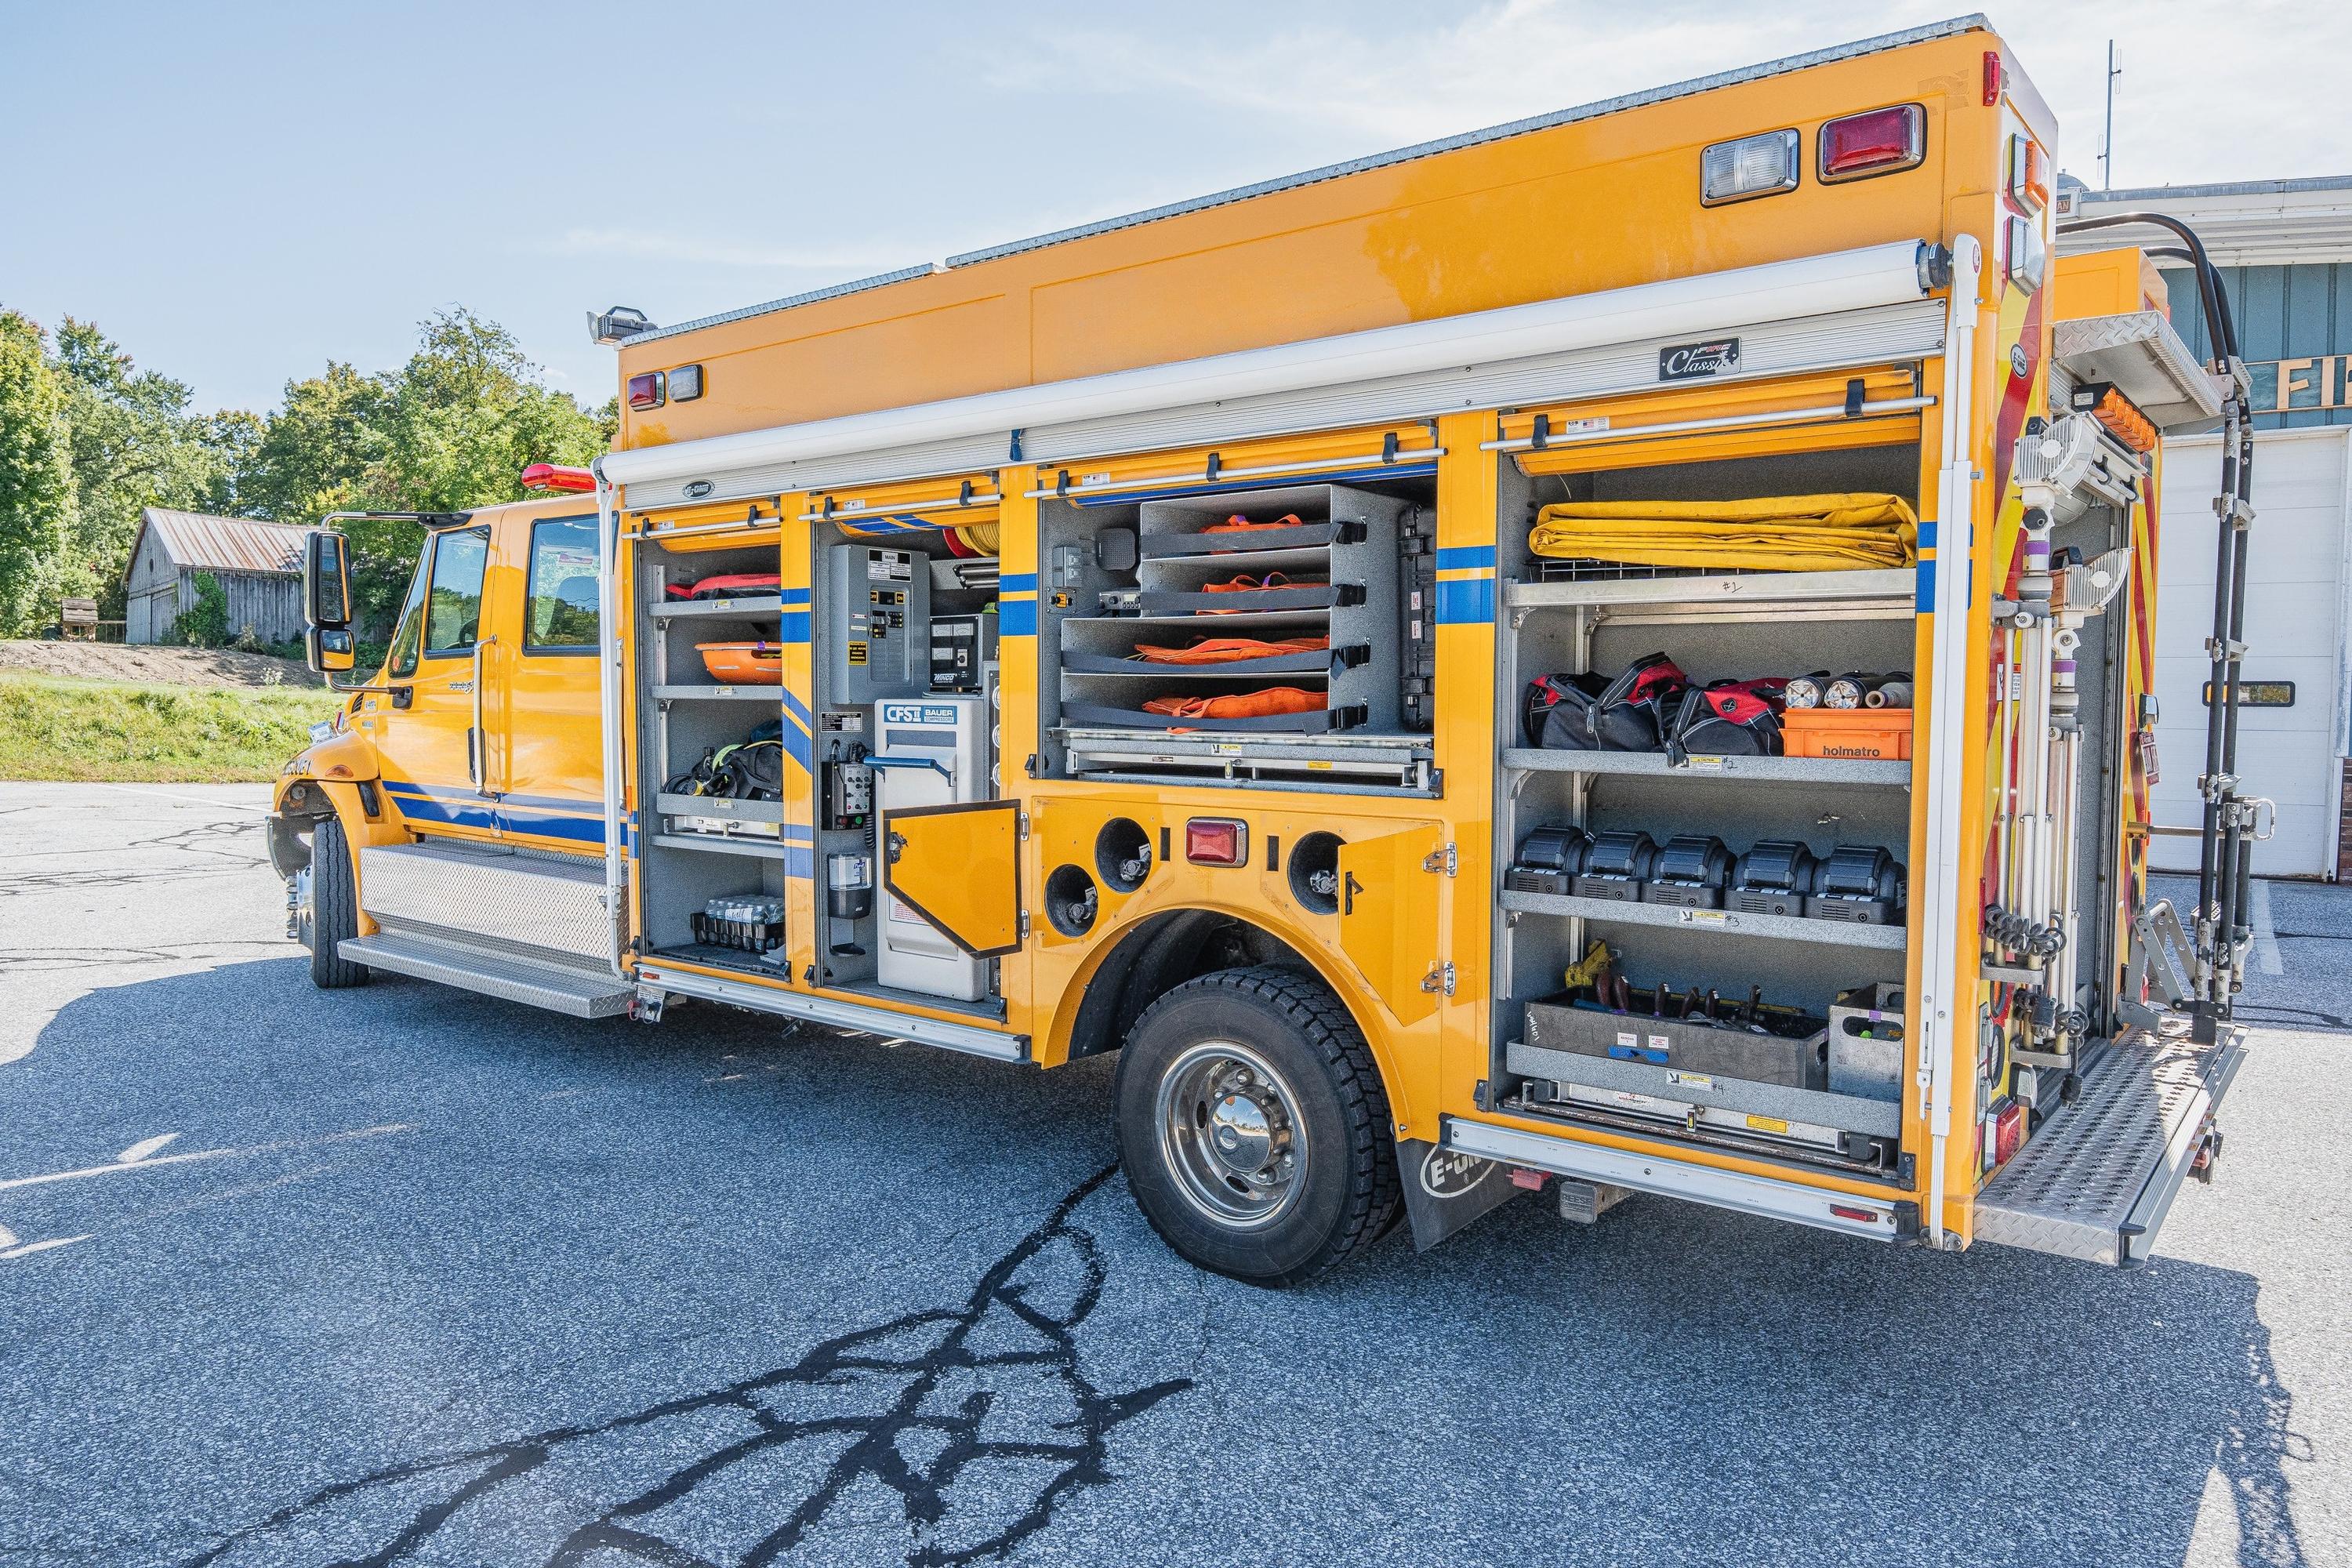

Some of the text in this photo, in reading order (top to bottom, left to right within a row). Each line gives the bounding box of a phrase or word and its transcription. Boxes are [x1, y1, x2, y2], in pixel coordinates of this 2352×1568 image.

[1667, 349, 1726, 375] Classi
[934, 673, 955, 681] WINCO
[1823, 745, 1880, 757] holmatro
